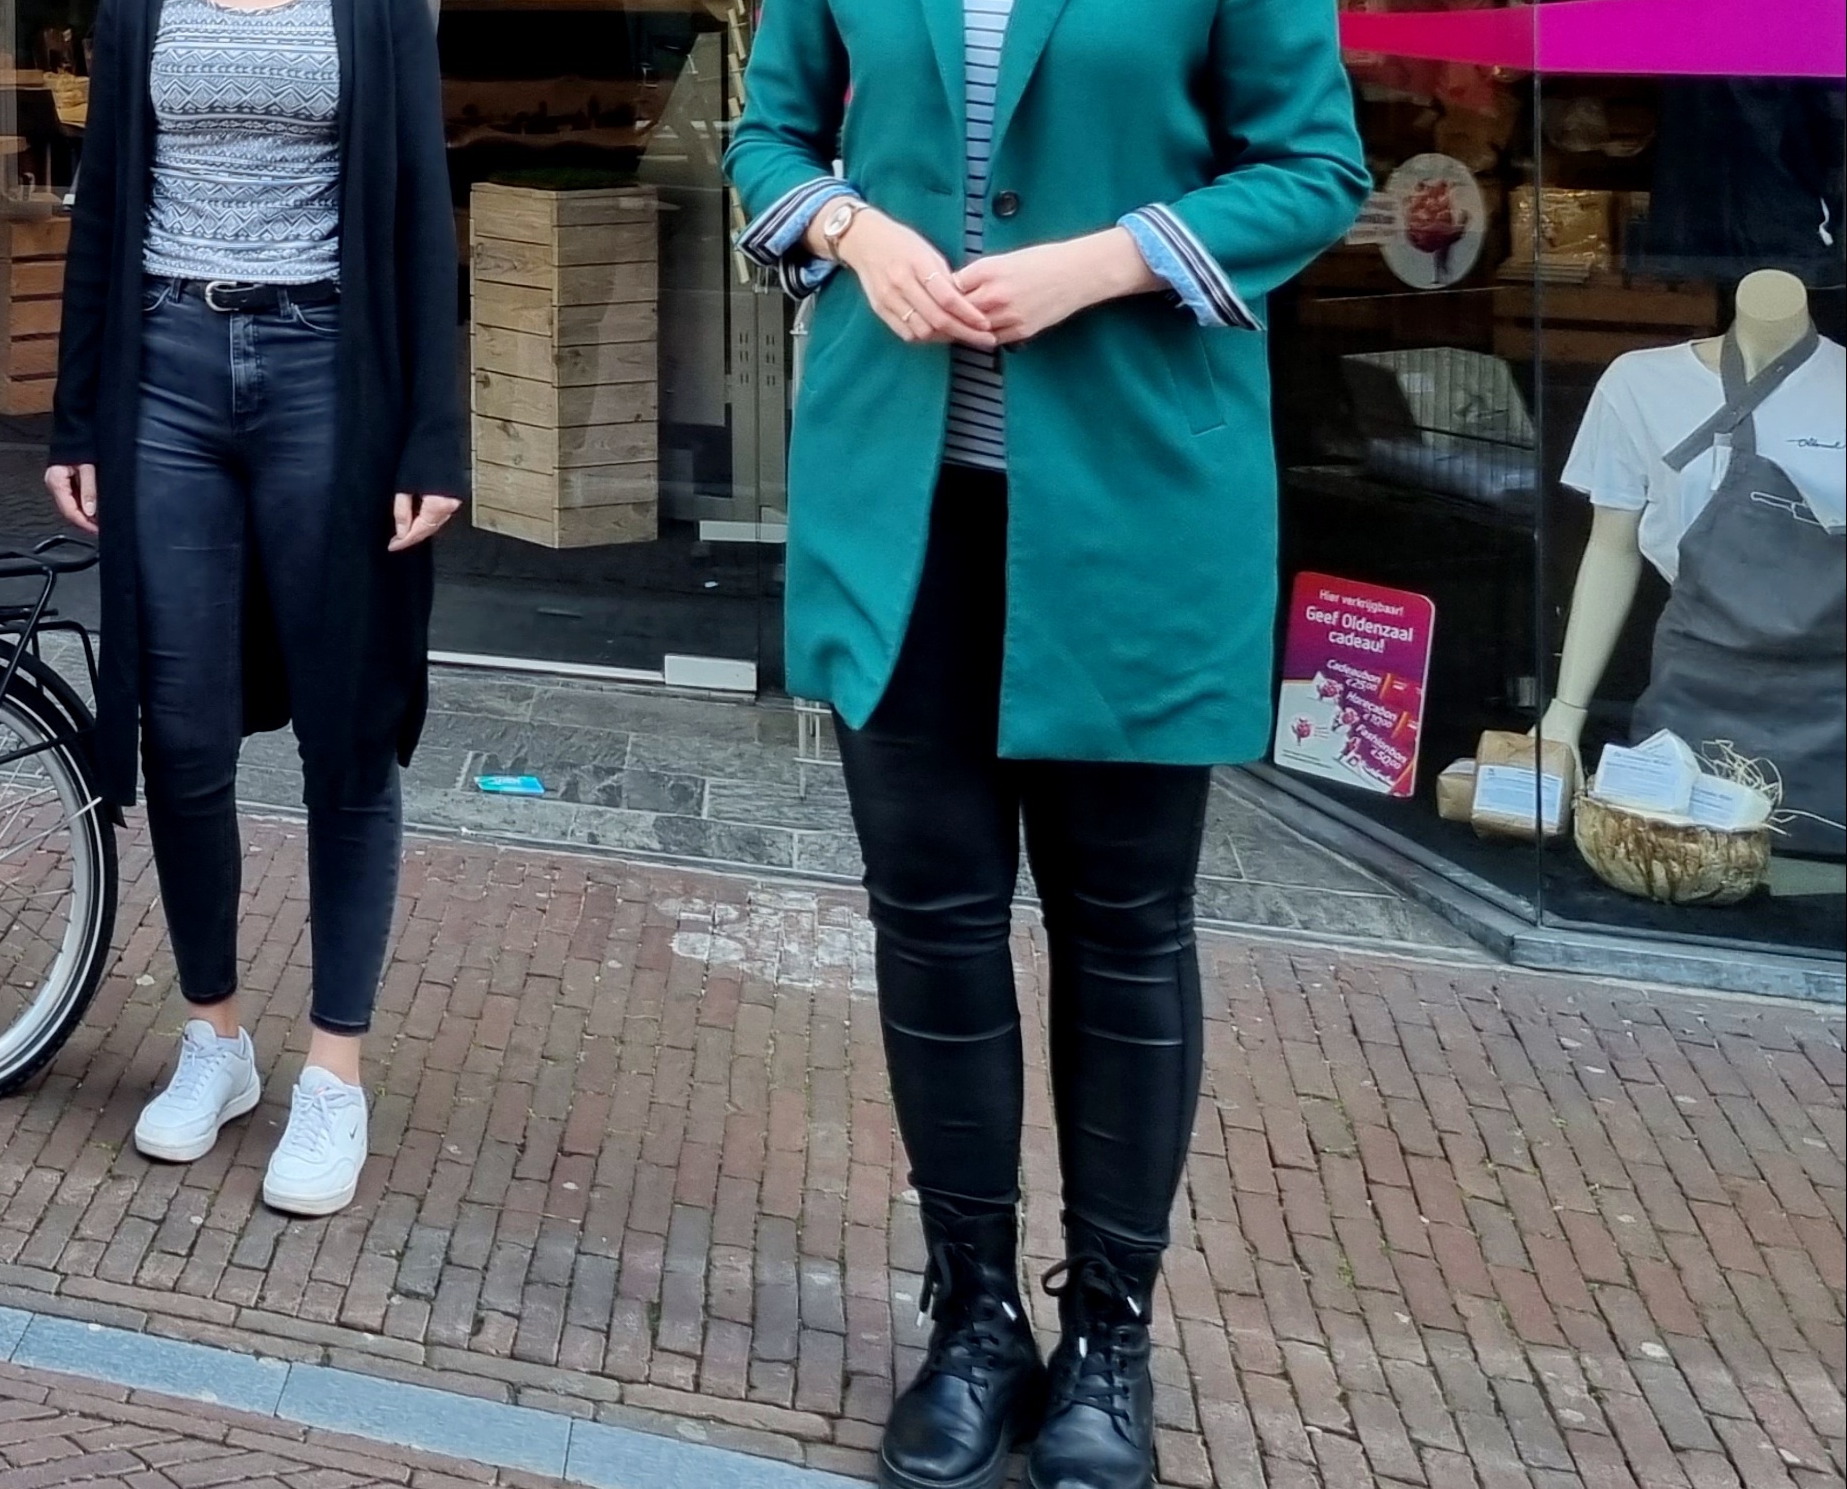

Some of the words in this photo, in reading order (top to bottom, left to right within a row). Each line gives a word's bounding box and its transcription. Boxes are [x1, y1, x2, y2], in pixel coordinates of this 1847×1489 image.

[1306, 606, 1340, 626] Geef
[1341, 613, 1414, 642] Oldenzaal
[1328, 631, 1385, 654] cadeau!
